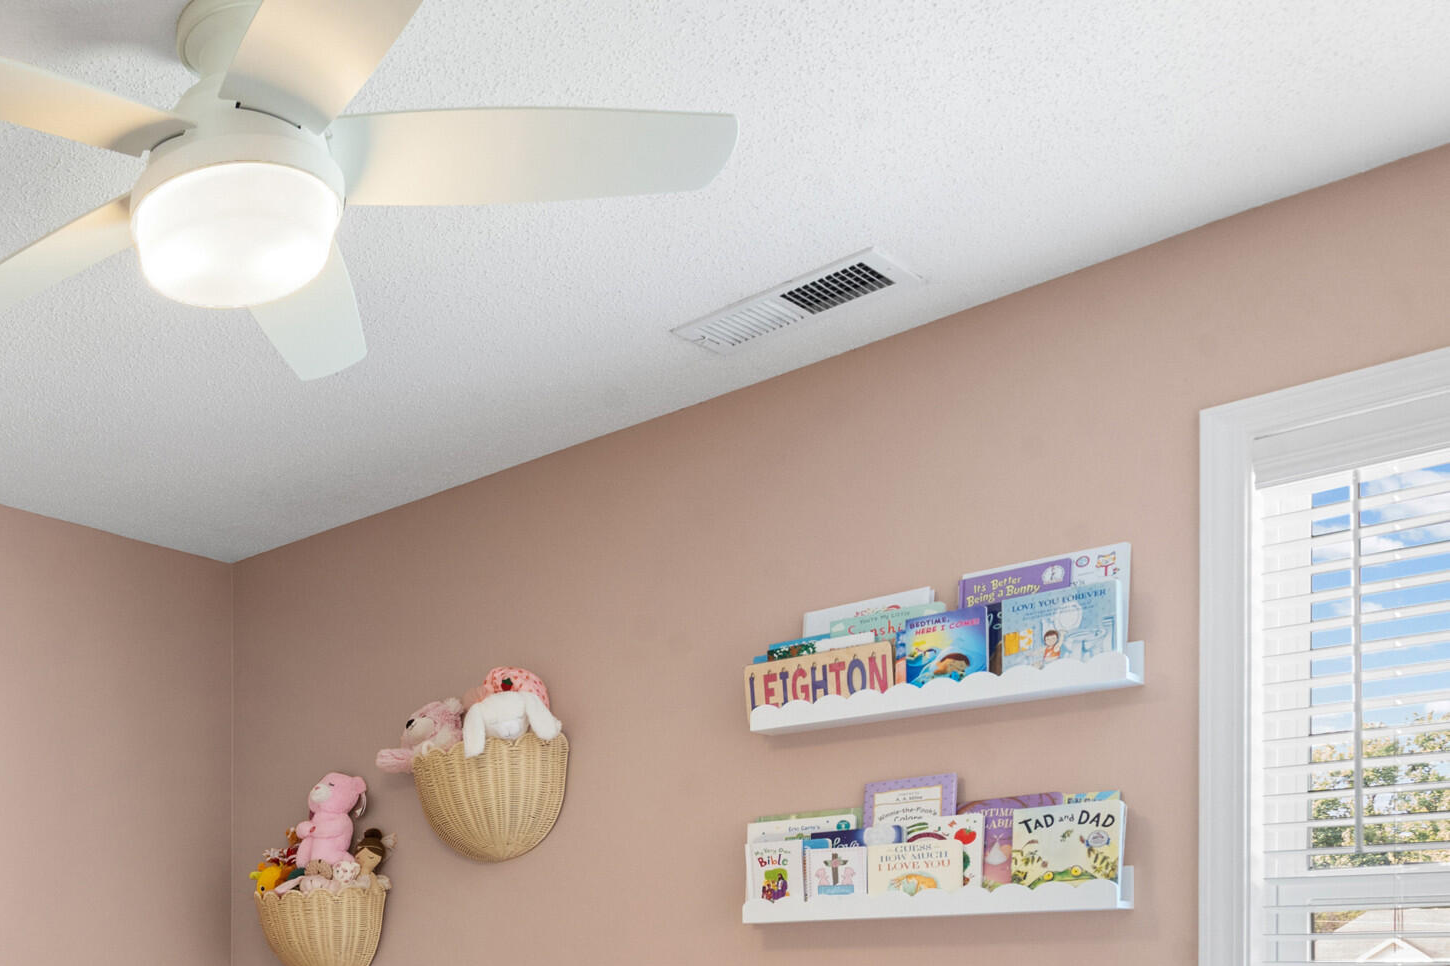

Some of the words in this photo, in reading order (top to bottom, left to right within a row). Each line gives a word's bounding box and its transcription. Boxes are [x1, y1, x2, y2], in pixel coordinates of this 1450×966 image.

[973, 583, 987, 594] It's
[990, 576, 1022, 590] Better
[966, 590, 996, 608] Being
[997, 589, 1004, 598] a
[1005, 584, 1040, 597] Bunny
[1012, 603, 1035, 612] LOVE
[1039, 597, 1060, 608] YOU
[1061, 588, 1107, 603] FOREVER
[915, 625, 937, 636] HERE
[749, 654, 888, 711] LEIGHTON
[1018, 813, 1055, 834] TAD
[1058, 813, 1075, 823] and
[1077, 809, 1115, 828] DAD
[894, 843, 932, 853] GUESS
[757, 853, 789, 868] Bible
[880, 853, 907, 863] HOW
[911, 850, 949, 860] MUCH
[887, 860, 920, 872] LOVE
[924, 858, 951, 869] YOU
